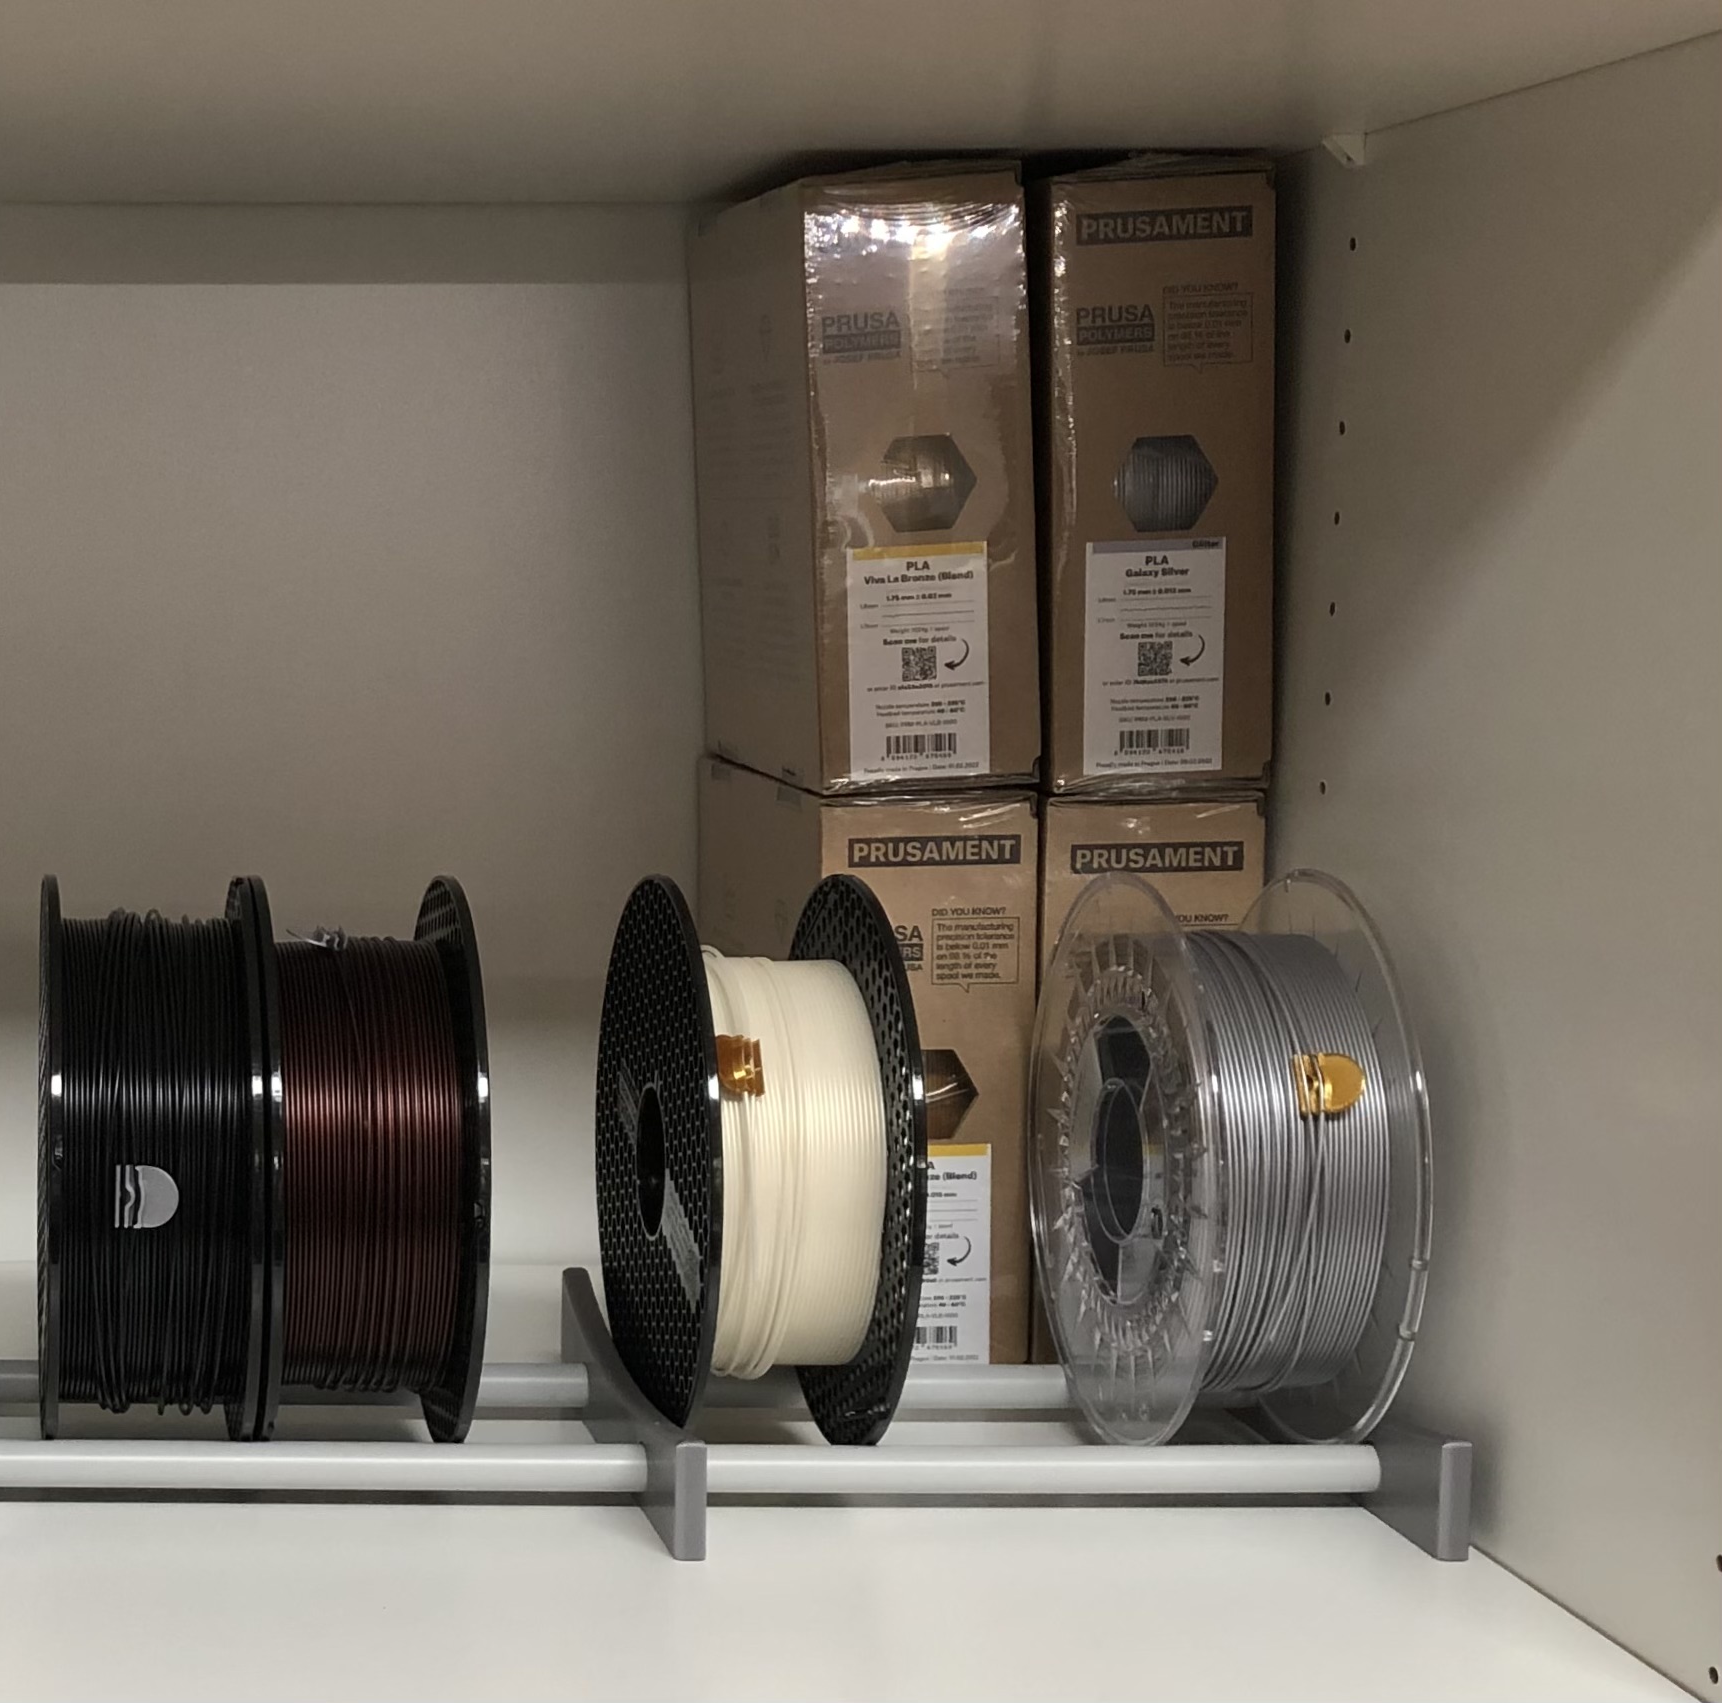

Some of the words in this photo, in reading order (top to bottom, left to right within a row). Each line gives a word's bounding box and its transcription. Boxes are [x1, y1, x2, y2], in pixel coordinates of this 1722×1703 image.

[1081, 211, 1247, 240] PRUSAMENT
[1163, 285, 1179, 294] DID
[1182, 284, 1201, 293] YOU
[1203, 282, 1238, 292] KNOW?
[1077, 304, 1154, 324] PRUSA
[822, 310, 900, 333] PRUSA
[1079, 327, 1152, 340] POLYMERS
[1192, 540, 1219, 548] Glitter
[1145, 555, 1169, 565] PLA
[906, 561, 930, 571] PLA
[864, 575, 886, 585] Viva
[888, 575, 899, 583] La
[901, 574, 936, 583] Bronze
[938, 571, 974, 582] (Blend)
[1125, 568, 1159, 578] Galaxy
[1161, 568, 1189, 577] Silver
[886, 594, 899, 602] 1.75
[883, 638, 902, 646] Scan
[931, 635, 957, 643] details
[853, 840, 1016, 863] PRUSAMENT
[1075, 847, 1238, 869] PRUSAMENT
[932, 908, 948, 916] DID
[951, 908, 970, 916] YOU
[972, 907, 1006, 915] KNOW?
[1176, 915, 1192, 923] OU
[1195, 914, 1228, 922] KNOW?
[937, 923, 953, 931] The
[955, 923, 1014, 932] manufacturing
[937, 933, 975, 942] precision
[936, 962, 961, 971] length
[974, 963, 997, 971] every
[936, 972, 959, 981] spool
[943, 1171, 977, 1181] (Blend)
